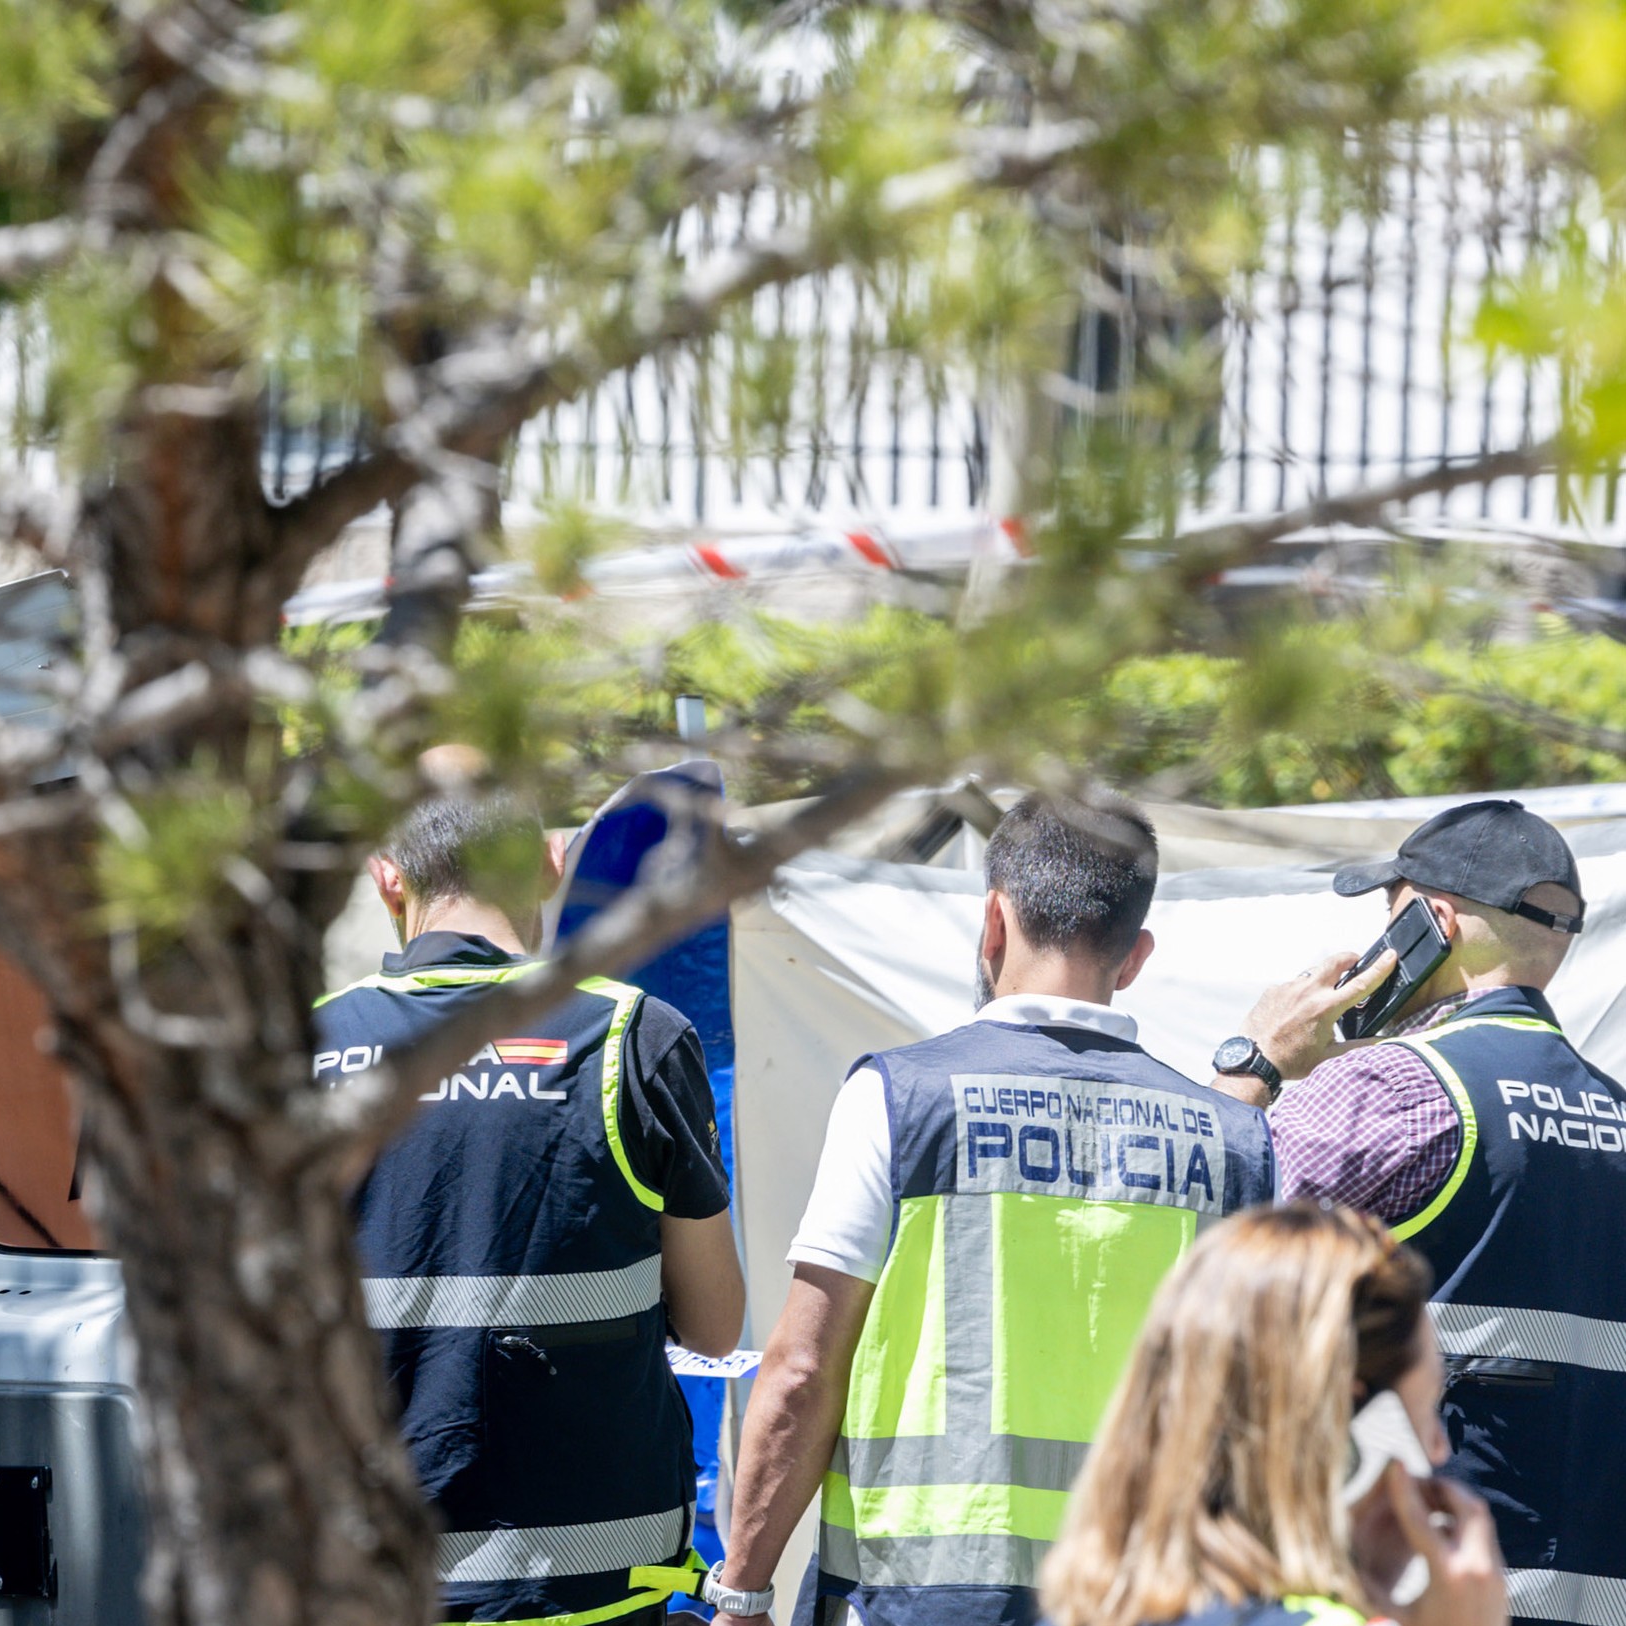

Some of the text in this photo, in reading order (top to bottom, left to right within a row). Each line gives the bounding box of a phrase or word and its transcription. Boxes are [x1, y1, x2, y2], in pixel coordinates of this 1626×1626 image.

[964, 1086, 1214, 1138] CUERPO NACIONAL DE
[1508, 1111, 1626, 1153] NACIO
[967, 1121, 1214, 1202] POLICIA
